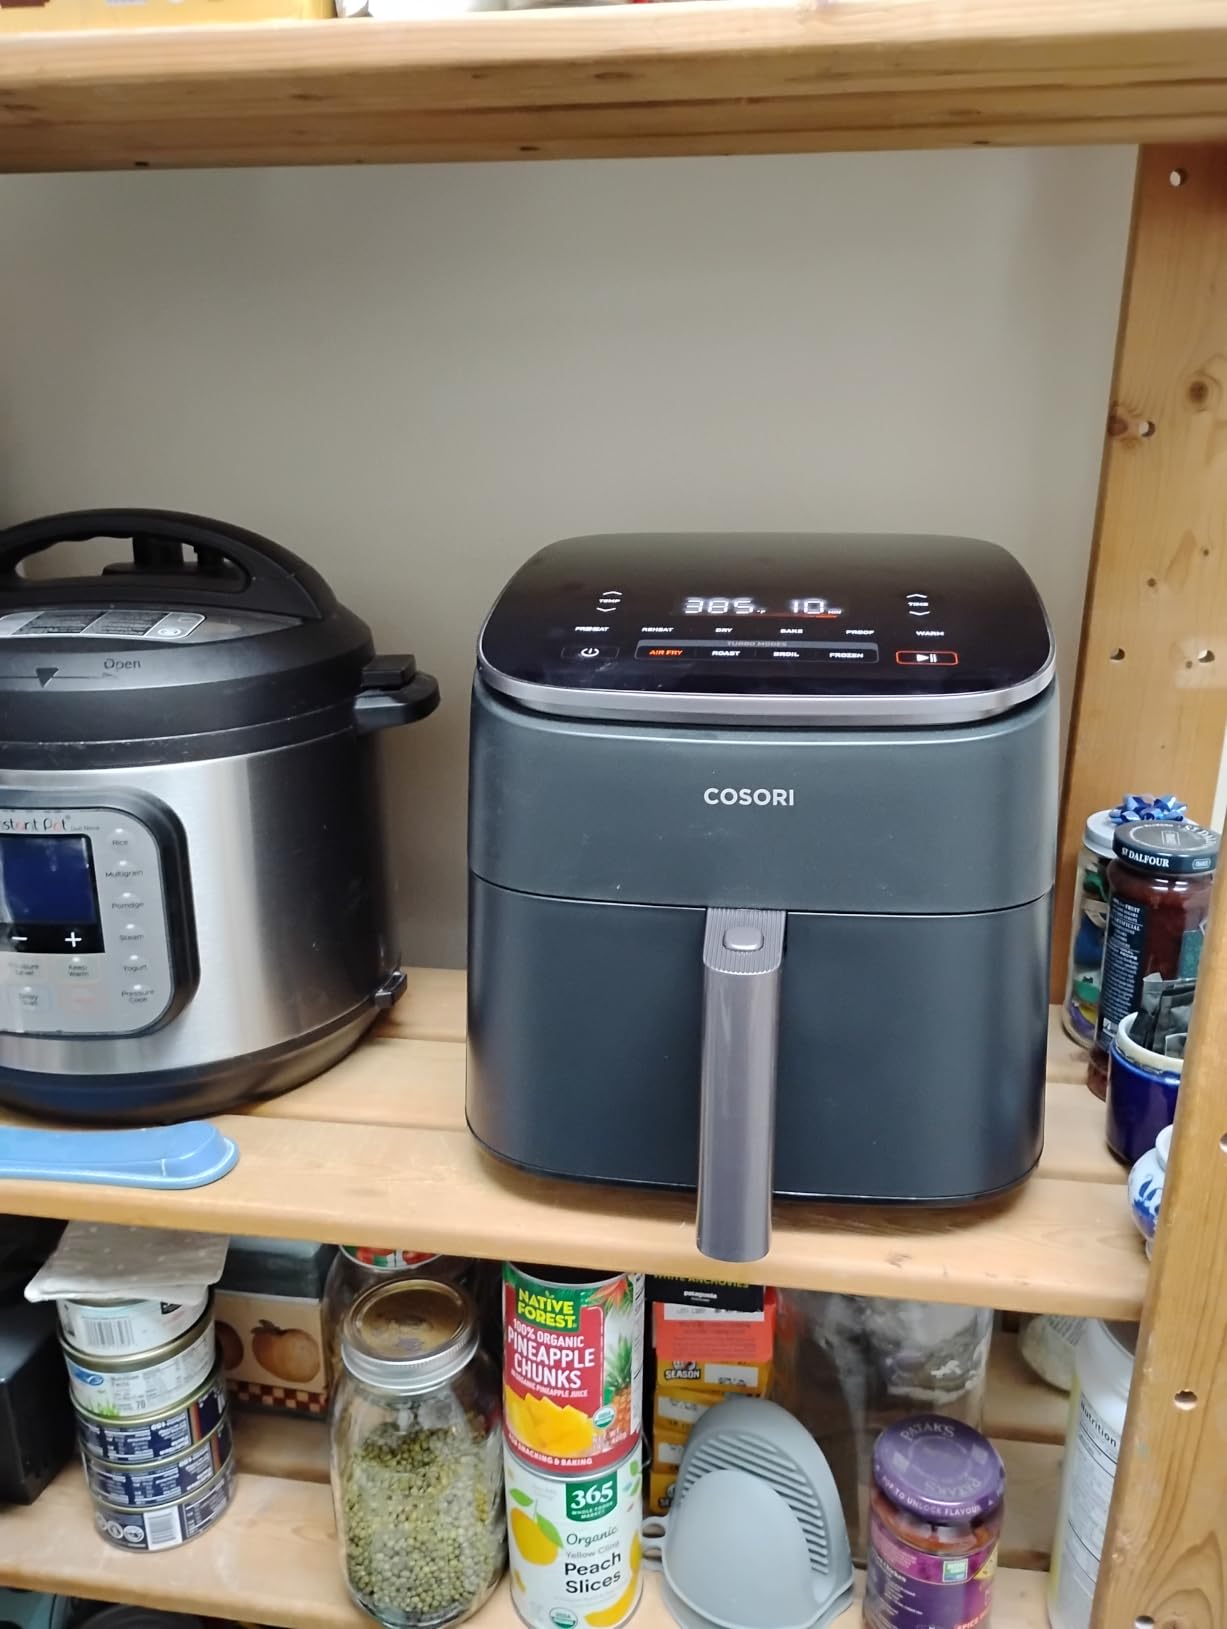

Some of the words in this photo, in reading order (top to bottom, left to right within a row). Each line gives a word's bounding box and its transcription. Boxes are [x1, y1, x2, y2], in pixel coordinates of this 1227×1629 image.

[685, 598, 754, 614] 385
[103, 658, 142, 671] Open
[703, 787, 794, 806] COSORI
[1129, 849, 1170, 868] DALFOUR
[518, 1288, 574, 1315] NATIVE
[517, 1302, 576, 1329] FOREST
[513, 1318, 536, 1340] 100%
[537, 1327, 585, 1348] ORGANIC
[508, 1326, 595, 1369] PINEAPPLE
[514, 1353, 581, 1389] CHUNKS
[665, 1369, 700, 1379] SEASON
[1080, 1401, 1117, 1447] Nutrition
[560, 1457, 592, 1467] BAKING
[570, 1480, 614, 1510] 365
[894, 1489, 905, 1500] TO
[906, 1498, 941, 1515] UNLOCK
[566, 1525, 618, 1548] Organic
[564, 1551, 622, 1576] Peach
[566, 1550, 596, 1560] Yellow
[565, 1570, 621, 1594] Slices
